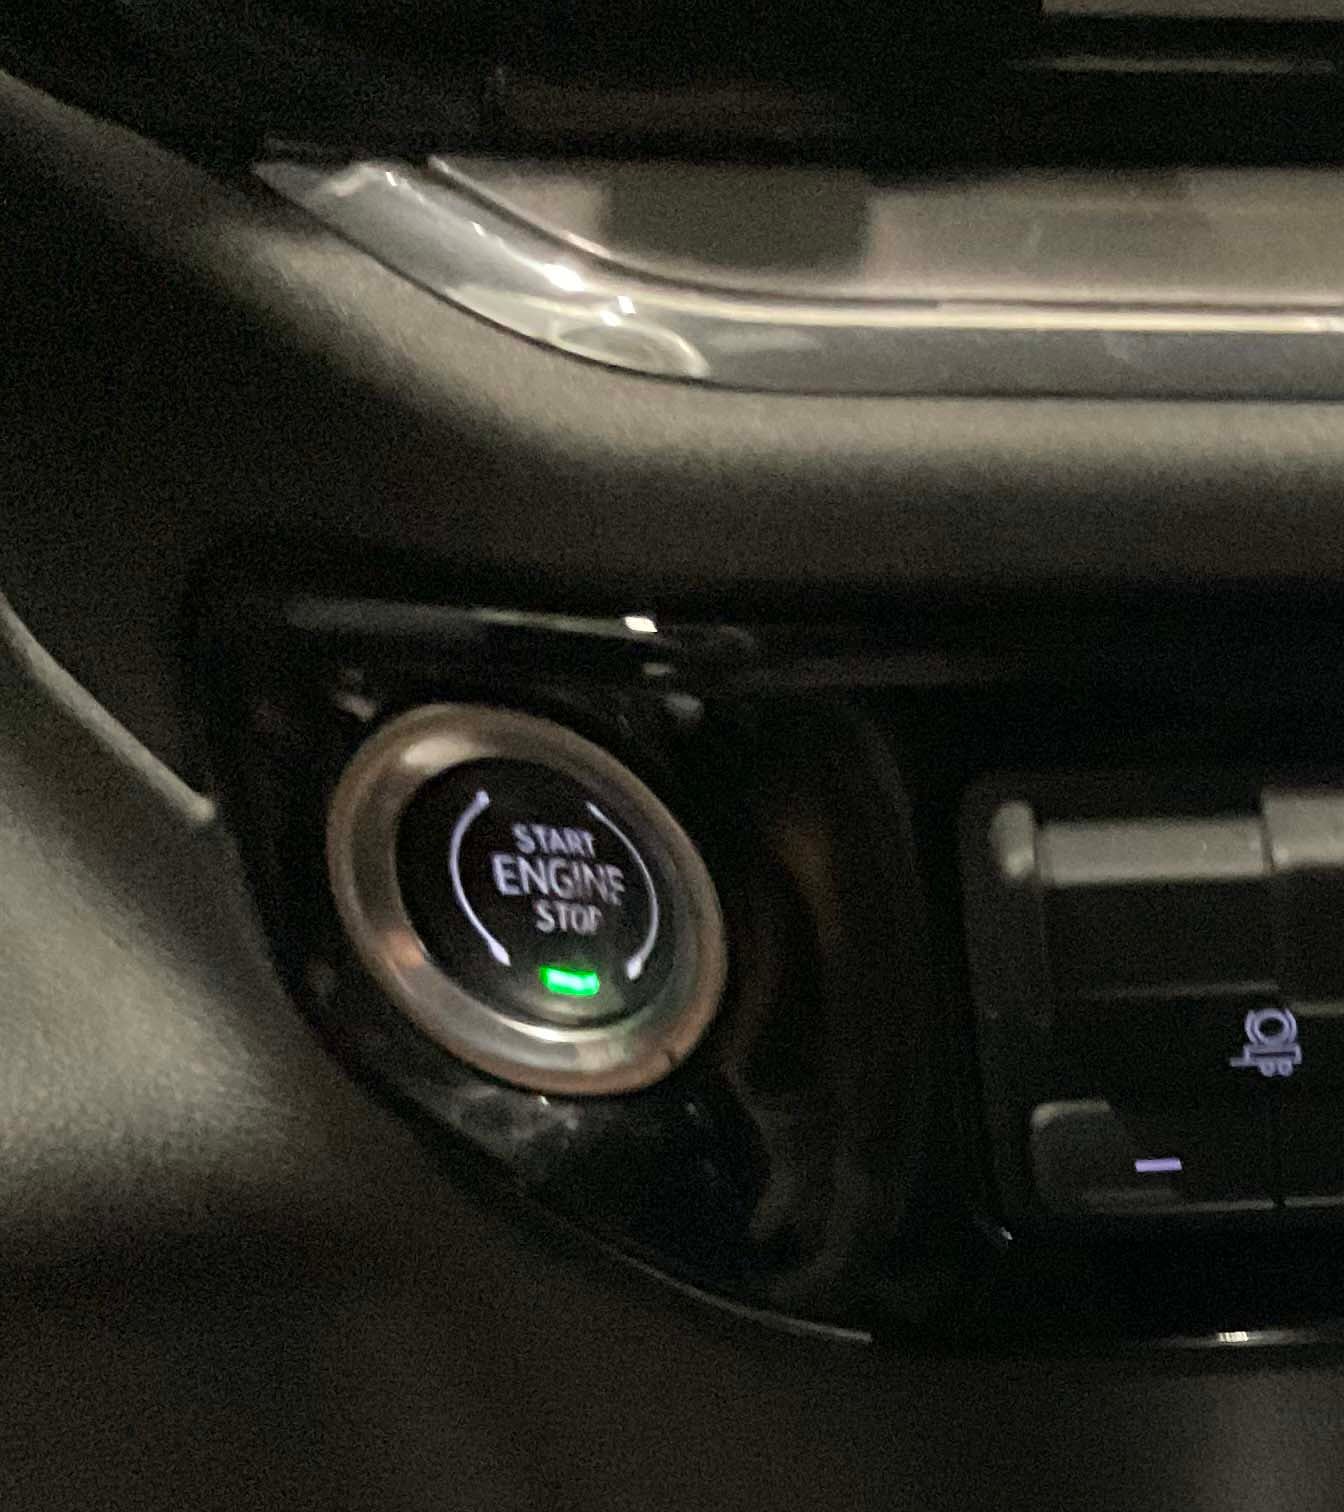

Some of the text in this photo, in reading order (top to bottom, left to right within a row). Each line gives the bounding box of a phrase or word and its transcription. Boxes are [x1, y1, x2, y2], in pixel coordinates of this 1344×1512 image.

[511, 822, 596, 859] START
[490, 852, 625, 907] ENGINE
[533, 900, 603, 935] STOP
